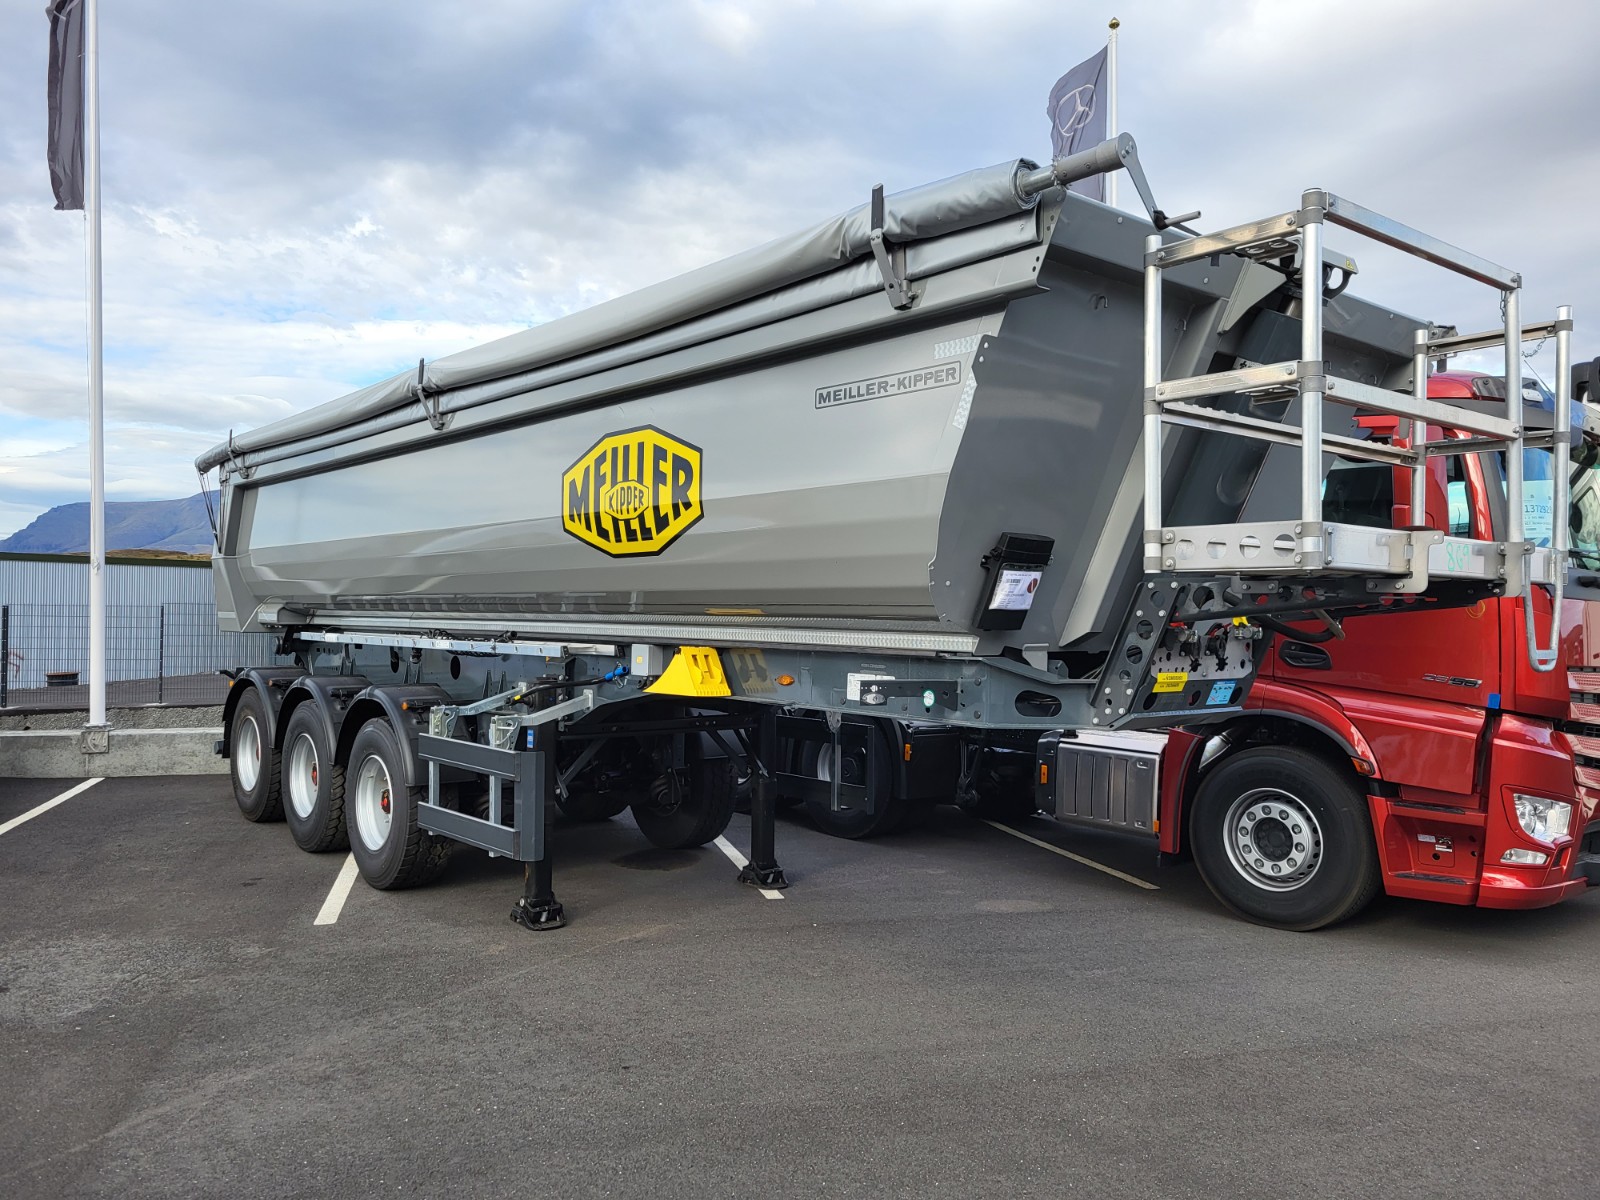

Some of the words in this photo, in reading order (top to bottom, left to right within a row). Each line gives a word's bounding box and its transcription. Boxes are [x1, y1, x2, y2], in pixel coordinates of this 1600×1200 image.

[818, 366, 957, 405] MEILLER-KIPPER
[568, 441, 694, 544] MEILLER
[608, 485, 645, 516] KIPPER
